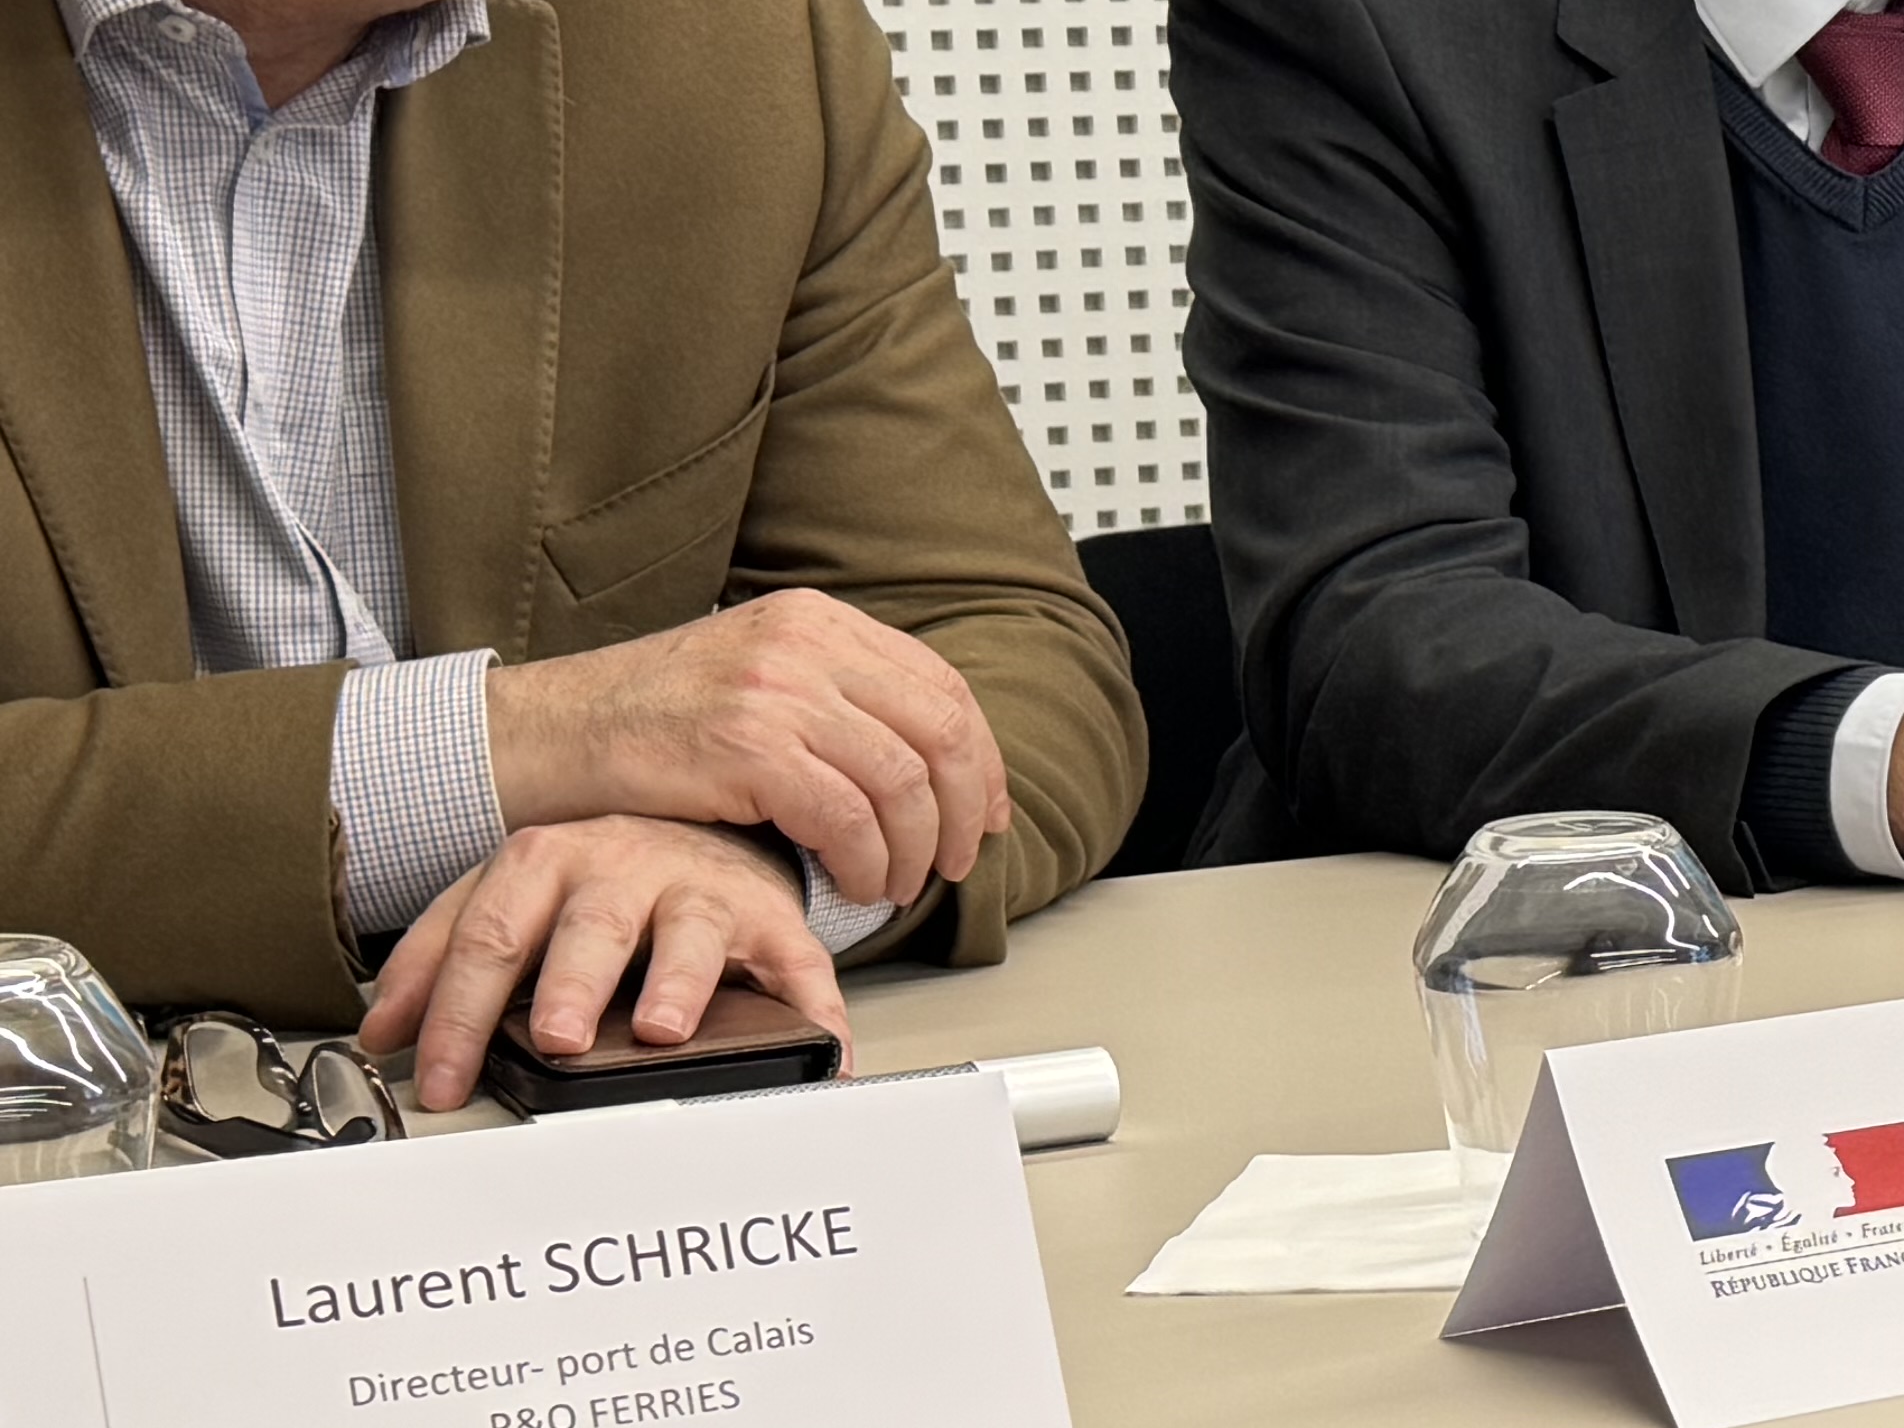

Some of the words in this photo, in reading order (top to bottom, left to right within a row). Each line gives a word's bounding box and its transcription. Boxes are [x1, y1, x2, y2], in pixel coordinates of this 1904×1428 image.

[271, 1254, 526, 1327] Laurent
[545, 1207, 857, 1292] SCHRICKE
[349, 1362, 543, 1406] Directeur-
[558, 1344, 638, 1385] port
[650, 1334, 694, 1365] de
[708, 1318, 814, 1356] Calais
[590, 1380, 740, 1428] FERRIES
